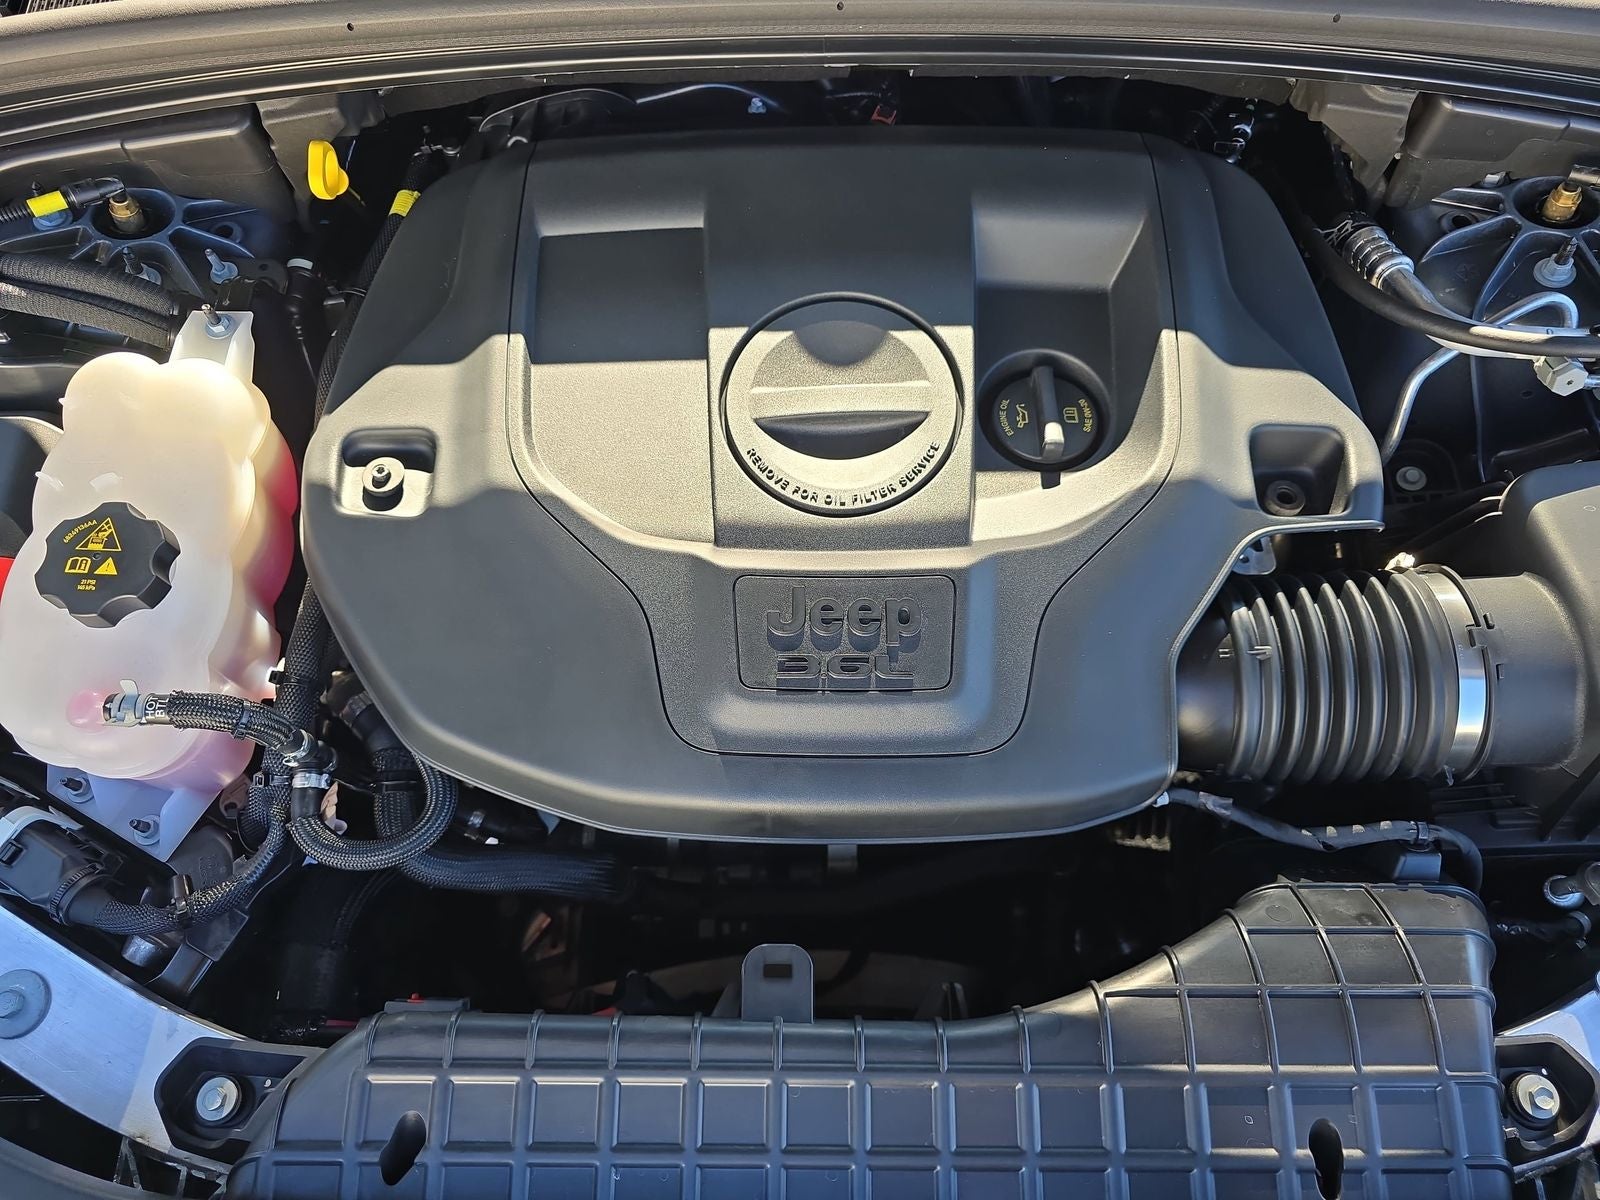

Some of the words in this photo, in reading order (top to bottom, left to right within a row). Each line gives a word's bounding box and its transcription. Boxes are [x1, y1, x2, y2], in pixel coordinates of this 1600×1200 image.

[1000, 399, 1010, 410] OIL
[999, 410, 1014, 437] ENGINE
[1082, 418, 1093, 433] SAE
[747, 448, 790, 491] REMOVE
[792, 485, 818, 502] FOR
[824, 494, 846, 507] OIL
[852, 483, 897, 506] FILTER
[898, 441, 941, 488] SERVICE
[766, 586, 922, 652] Jeep
[145, 695, 158, 719] HOT
[155, 697, 170, 718] BTL
